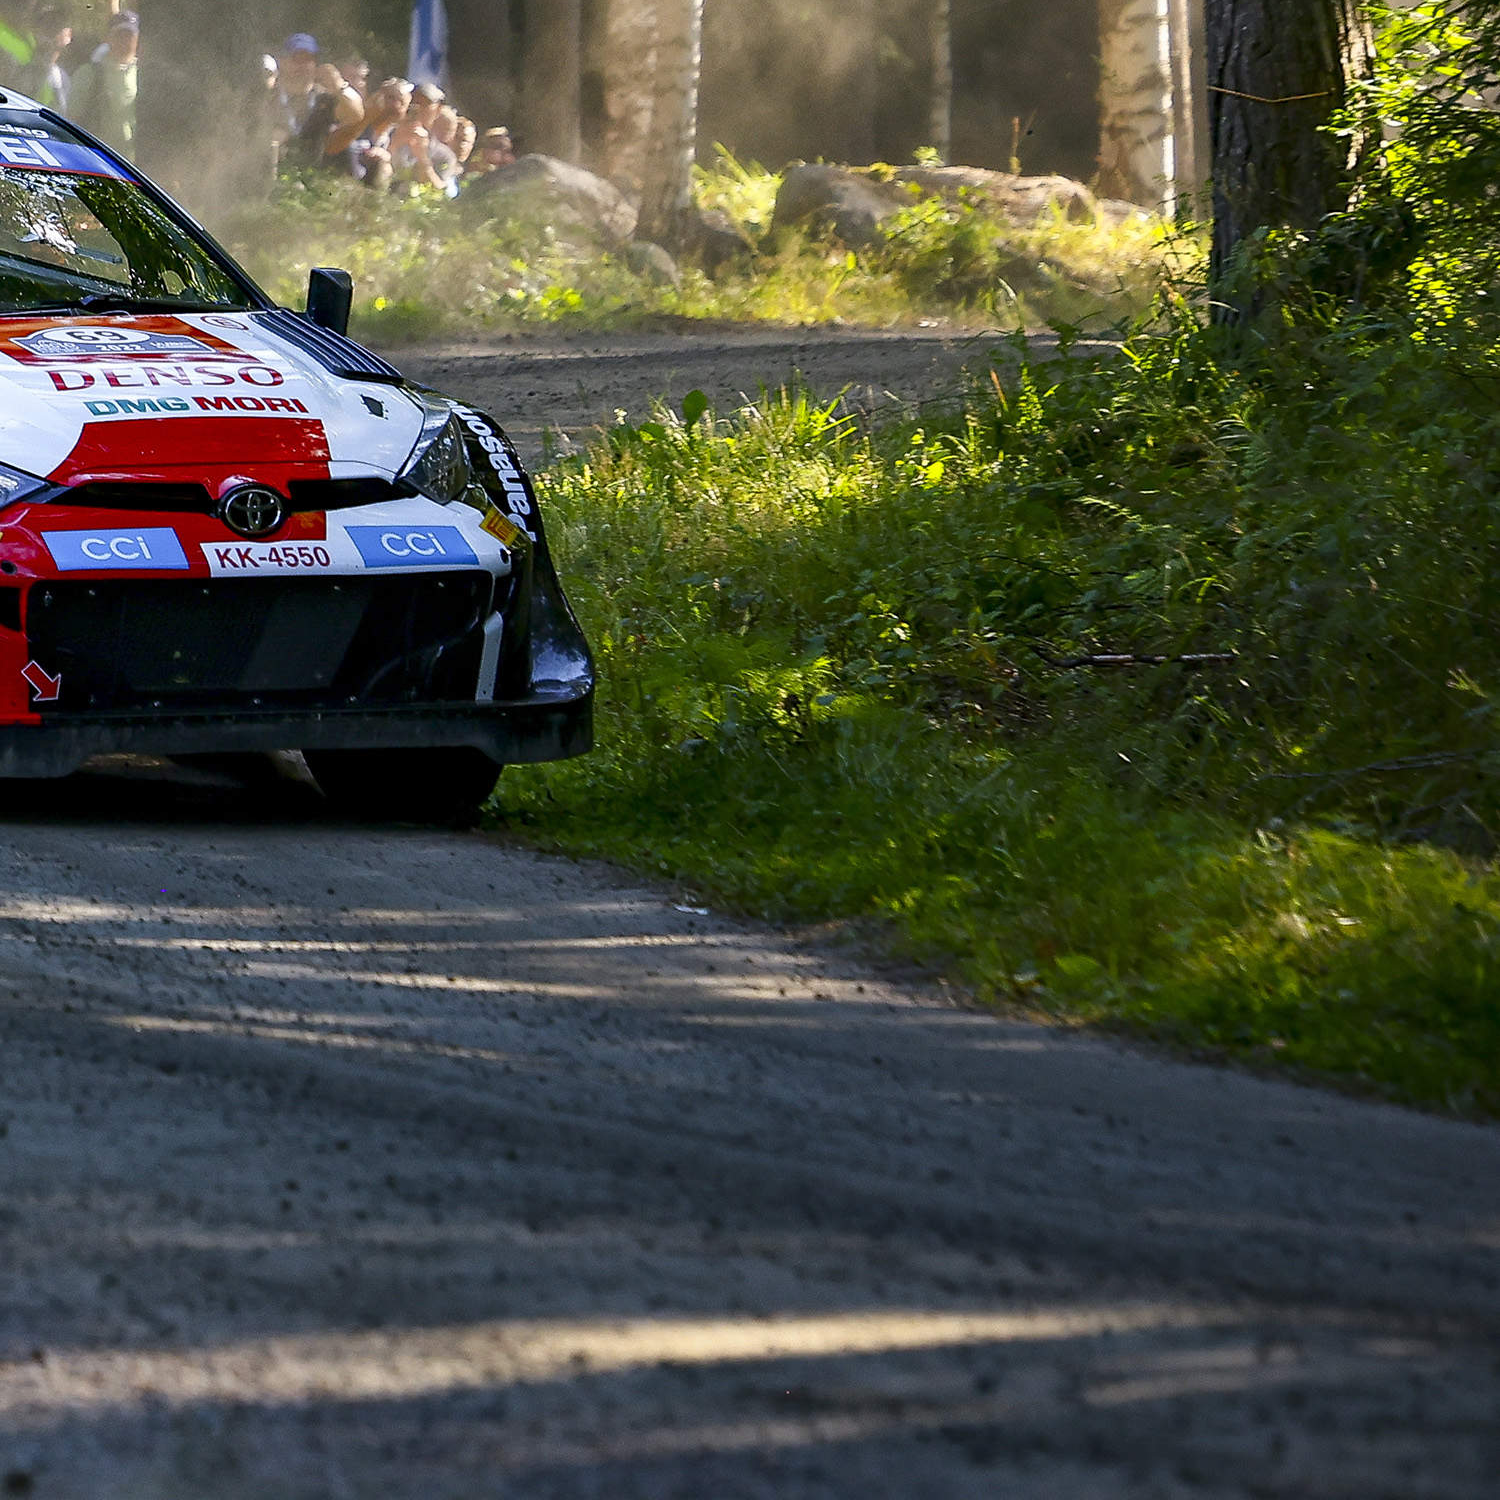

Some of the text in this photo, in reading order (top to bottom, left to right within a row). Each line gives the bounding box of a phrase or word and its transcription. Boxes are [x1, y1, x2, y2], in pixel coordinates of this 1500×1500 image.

[66, 330, 129, 341] 69
[45, 366, 284, 392] DENSO
[83, 396, 310, 417] DMG MORI
[213, 546, 331, 569] KK-4550
